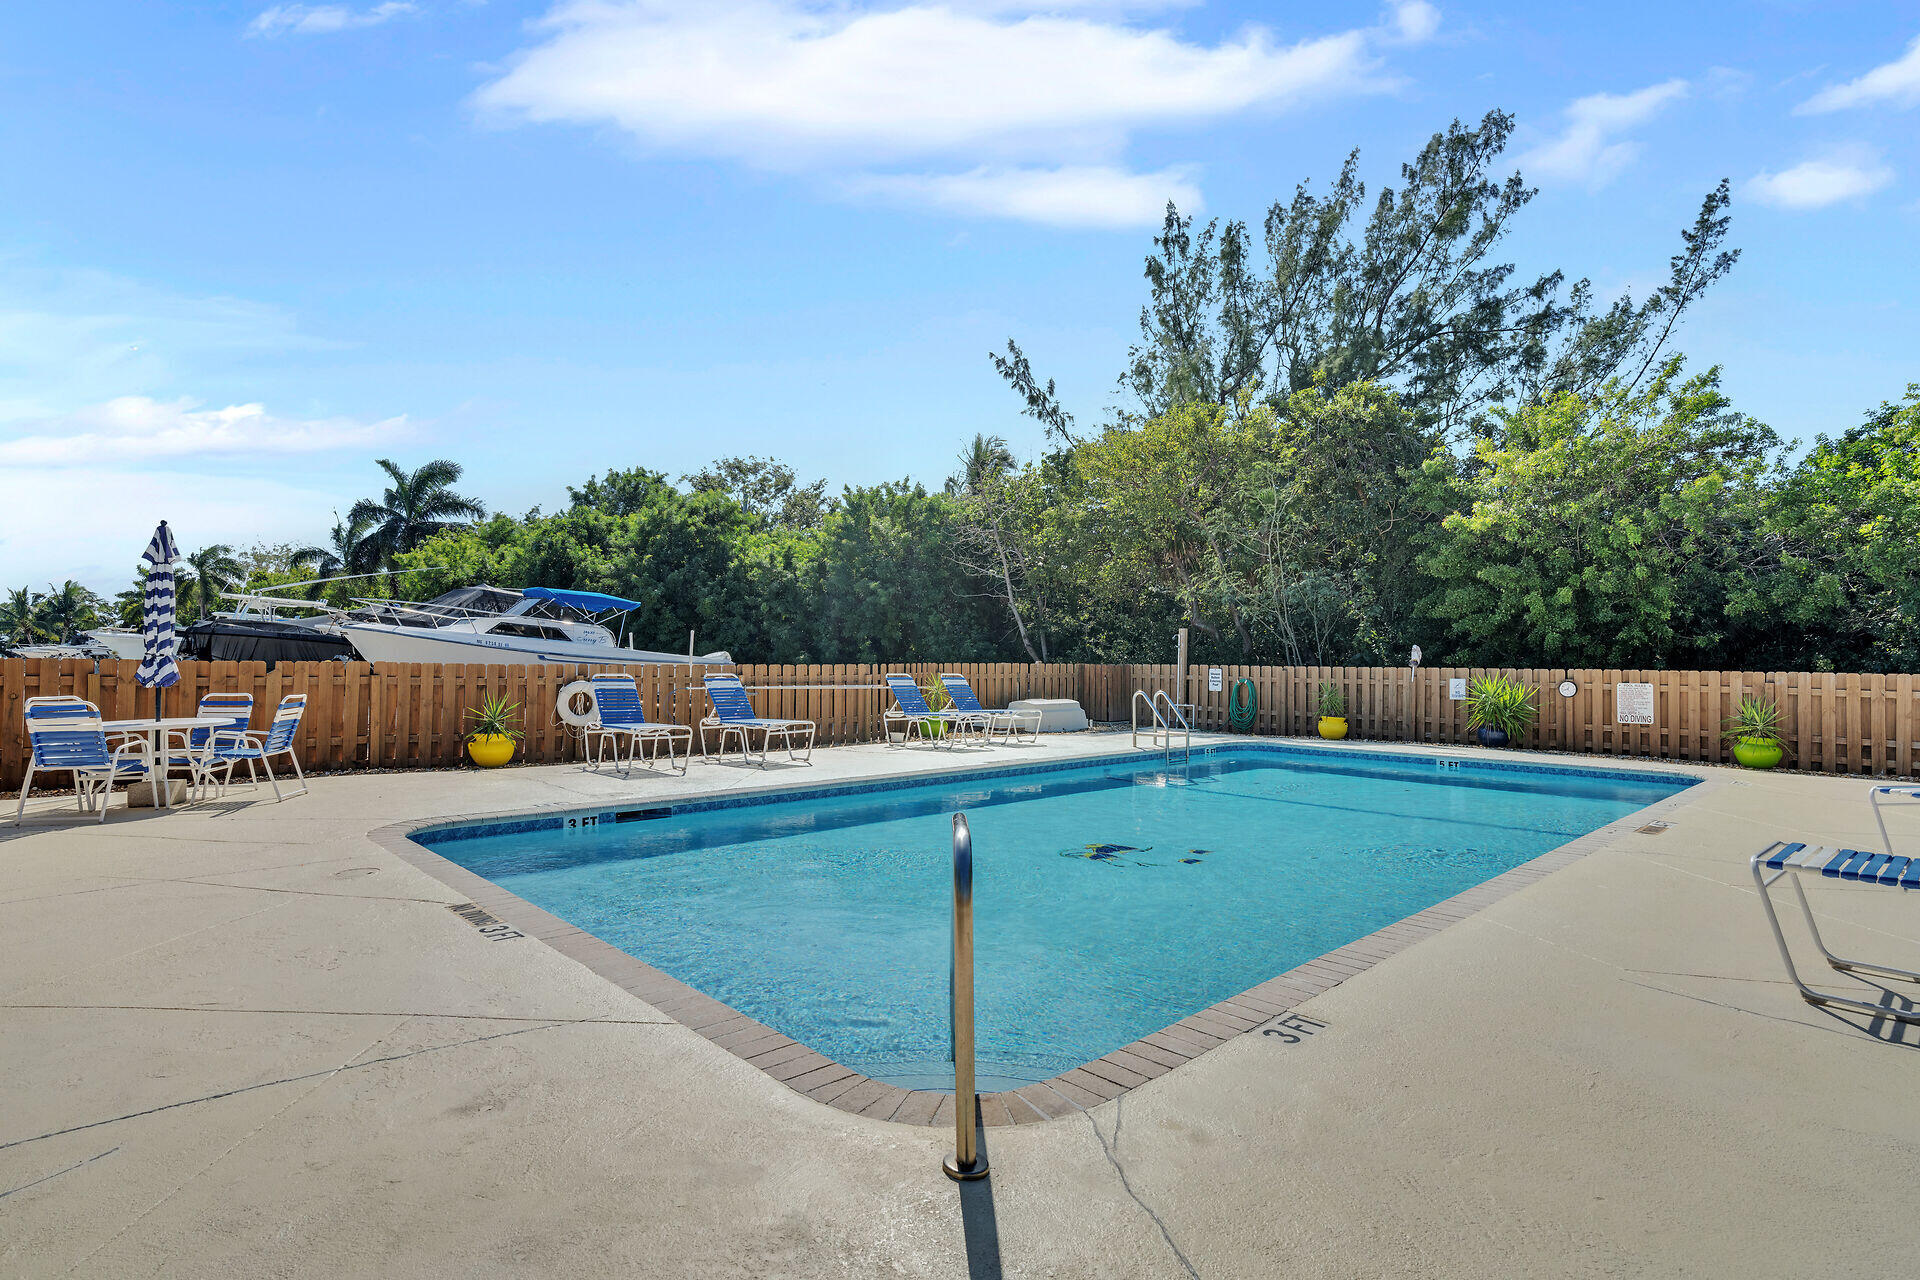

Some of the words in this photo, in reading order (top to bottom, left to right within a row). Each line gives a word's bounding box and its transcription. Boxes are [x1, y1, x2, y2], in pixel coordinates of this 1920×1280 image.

[1631, 714, 1652, 723] DIVING
[568, 818, 577, 828] 3
[582, 816, 597, 827] FT
[483, 931, 525, 942] FT
[1277, 1014, 1326, 1035] FT
[1263, 1029, 1301, 1043] 3
